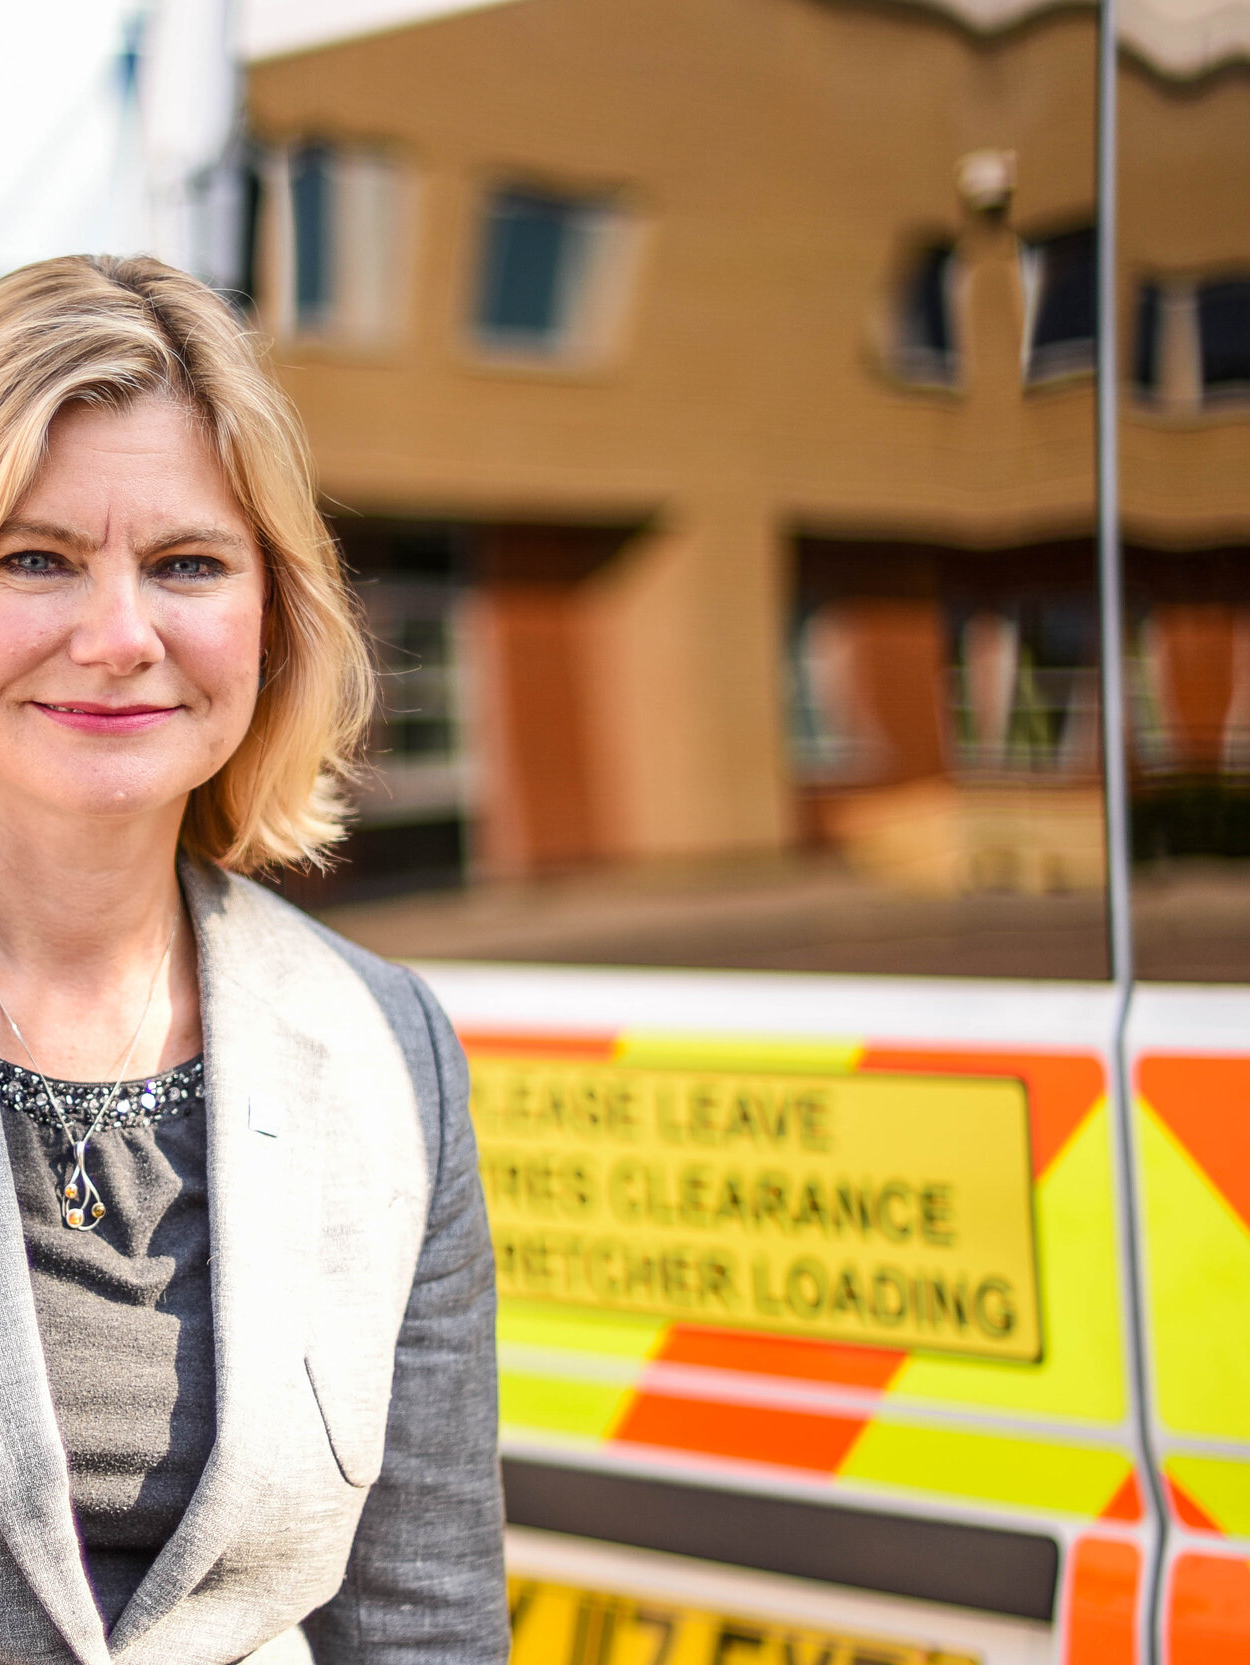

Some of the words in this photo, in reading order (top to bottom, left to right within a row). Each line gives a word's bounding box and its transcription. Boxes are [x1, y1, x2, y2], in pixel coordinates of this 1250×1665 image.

[656, 1083, 834, 1152] LEAVE
[479, 1150, 593, 1217] RES
[608, 1155, 958, 1244] CLEARANCE
[495, 1230, 737, 1306] RETCHER
[752, 1254, 1018, 1338] LOADING
